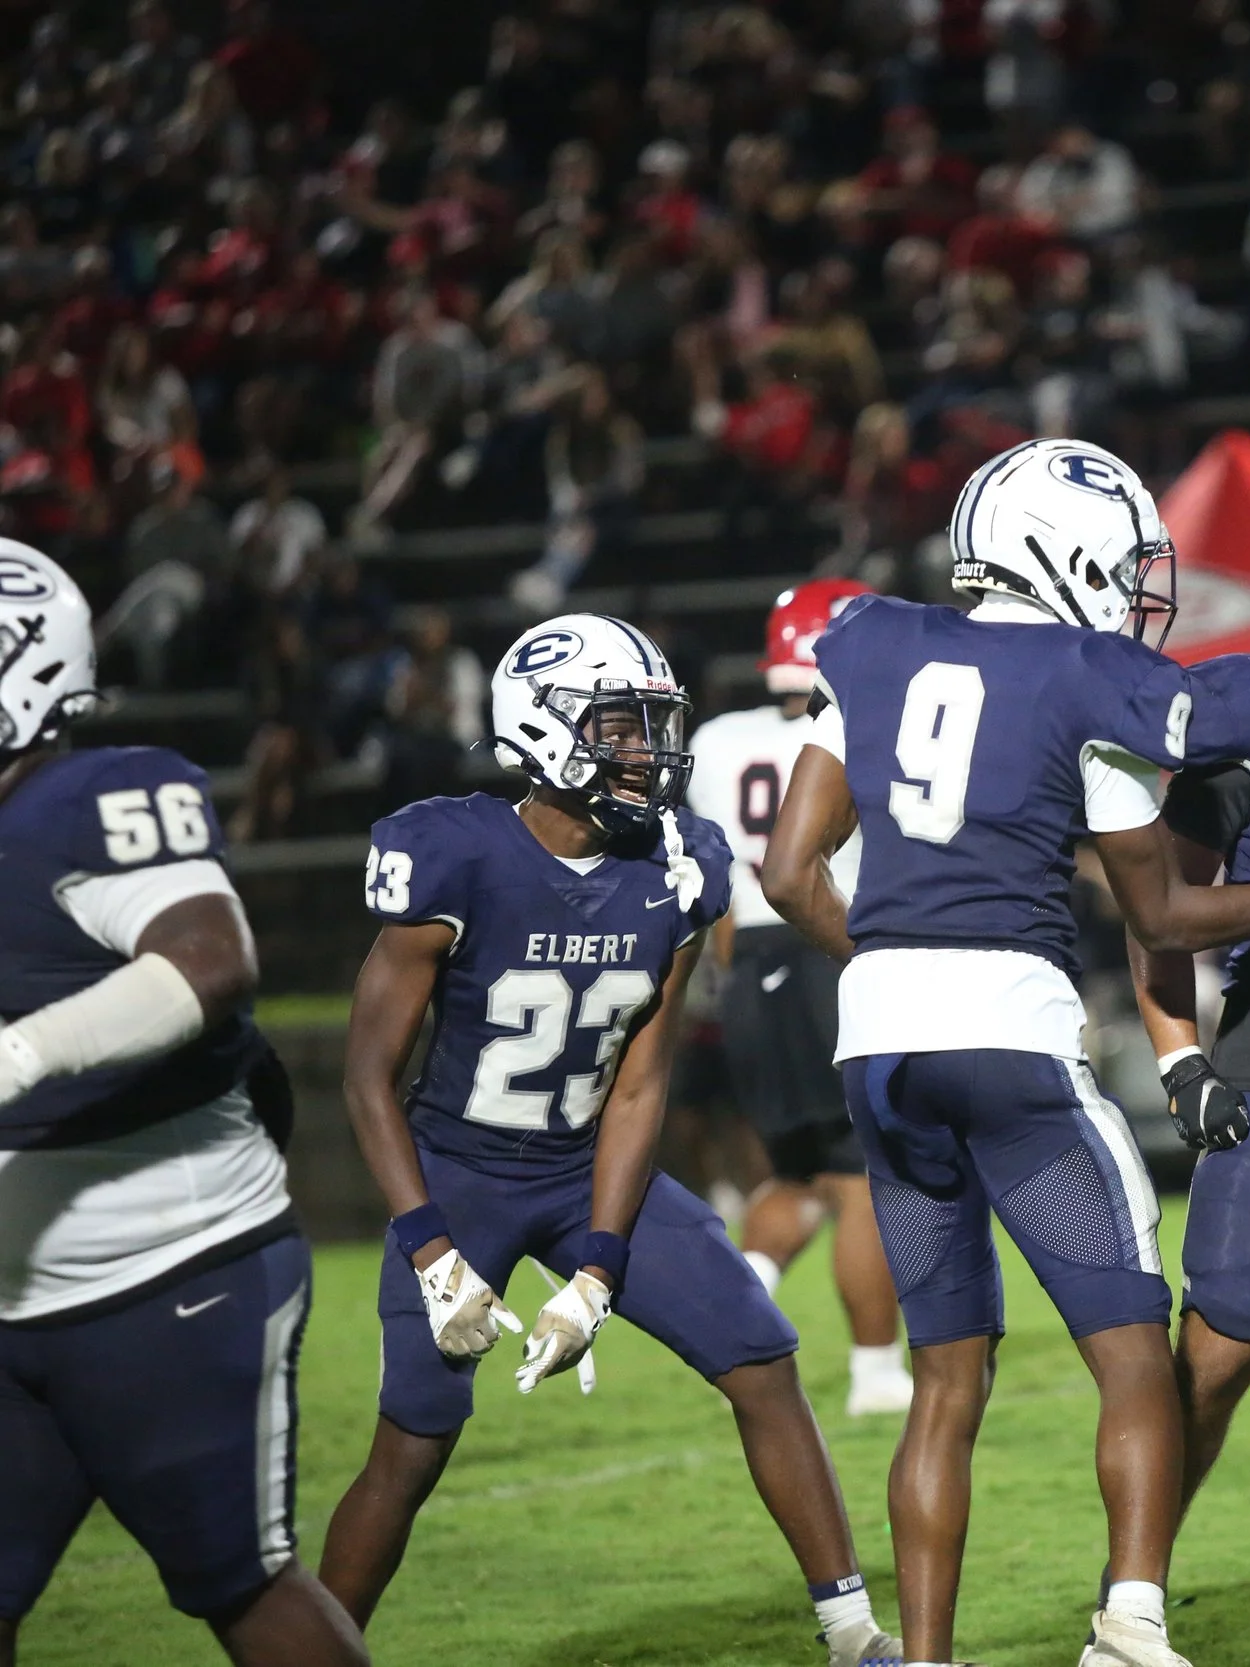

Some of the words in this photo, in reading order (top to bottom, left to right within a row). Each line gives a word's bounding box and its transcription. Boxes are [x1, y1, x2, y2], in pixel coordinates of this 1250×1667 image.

[512, 633, 573, 673] E
[889, 661, 985, 844] 9
[1165, 691, 1192, 759] 9
[96, 782, 210, 865] 56
[365, 844, 413, 914] 23
[525, 933, 638, 964] ELBERT
[463, 968, 655, 1131] 23
